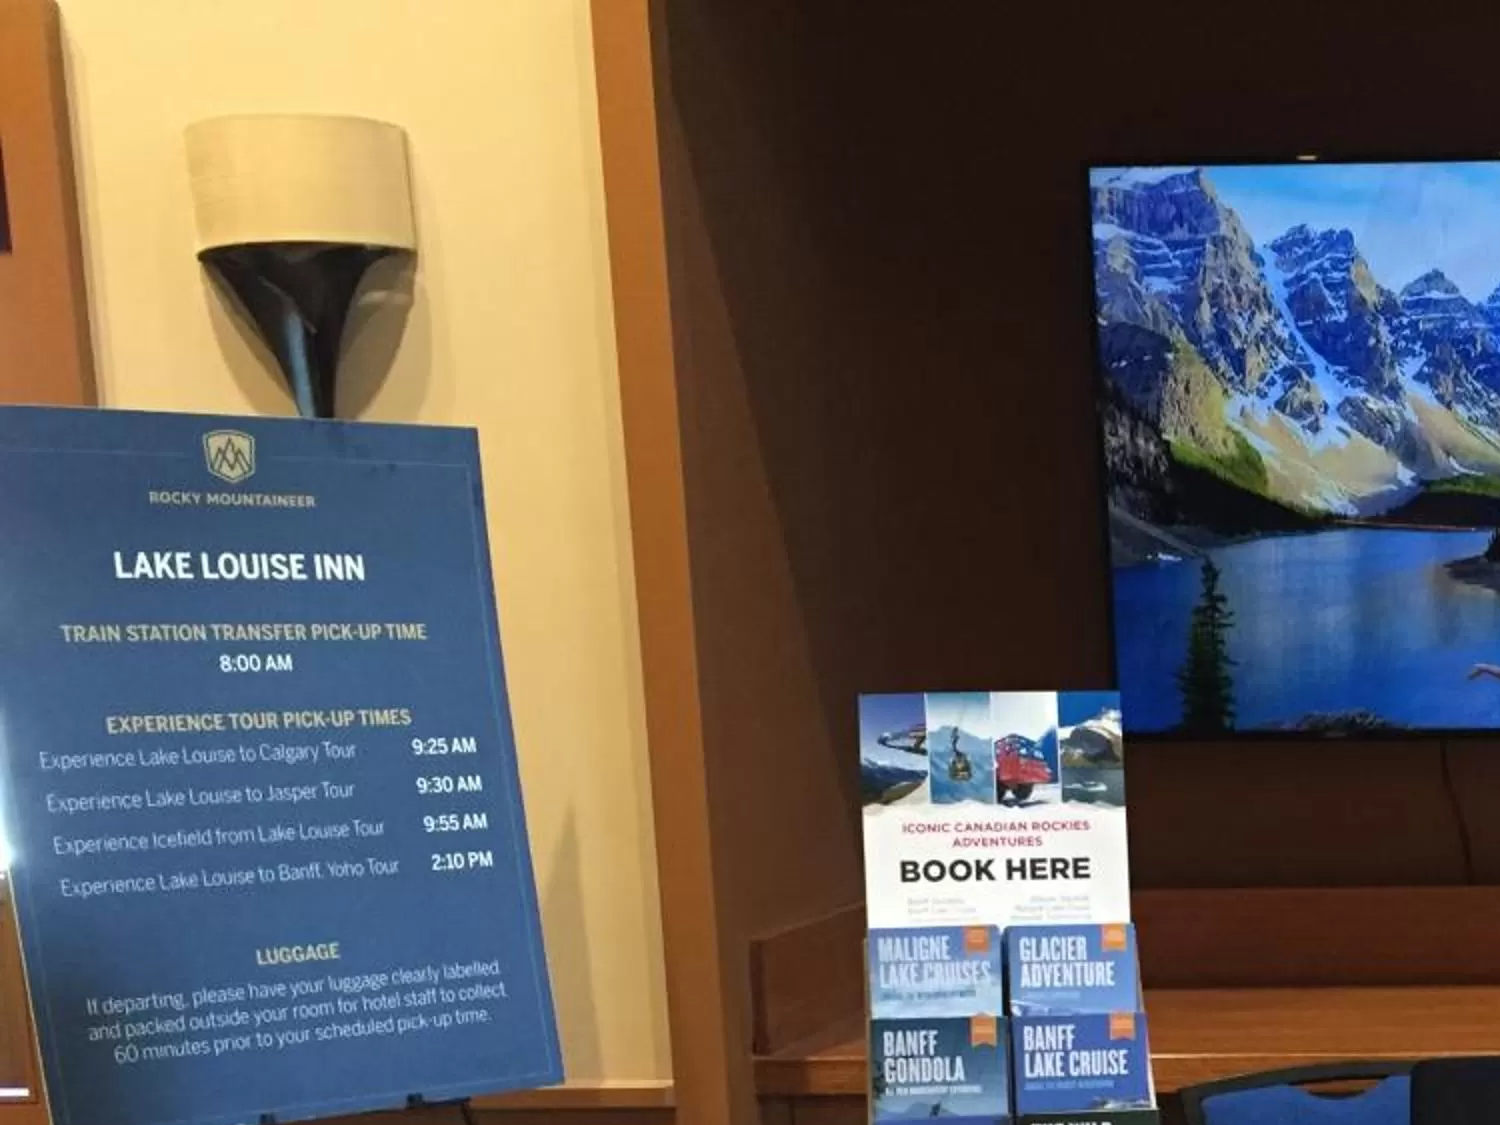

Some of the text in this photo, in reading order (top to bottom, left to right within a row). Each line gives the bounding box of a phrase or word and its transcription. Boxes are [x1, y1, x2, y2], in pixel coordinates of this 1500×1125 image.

[149, 491, 316, 508] ROCKY MOUNTAINEER
[113, 551, 365, 581] LAKE LOUISE INN
[59, 623, 427, 642] TRAIN STATION TRANSFER PICK-UP TIME
[219, 654, 293, 672] 8:00 AM
[106, 708, 412, 735] EXPERIENCE TOUR PICK-UP TIMES
[39, 741, 357, 773] Experience Lake Louise to Calgary Tour
[411, 736, 477, 755] 9:25 AM
[46, 781, 356, 815] Experience Lake Louise to Jasper Tour
[416, 775, 483, 794] 9:30 AM
[423, 813, 488, 833] 9:55 AM
[901, 820, 1091, 834] ICONIC CANADIAN ROCKIES
[53, 819, 385, 856] Experience Icefield from Lake Louise Tour
[952, 836, 1043, 848] ADVENTURES
[431, 851, 493, 871] 2:10 PM
[900, 857, 1091, 883] BOOK HERE
[60, 877, 155, 898] Experience
[158, 874, 199, 891] Lake
[201, 869, 255, 888] Louise
[257, 867, 275, 884] to
[326, 860, 366, 878] Yoho
[367, 857, 400, 876] Tour
[256, 942, 340, 965] LUGGAGE
[877, 936, 952, 963] MALIGNE
[1019, 936, 1088, 961] GLACIER
[879, 960, 992, 989] LAKE CRUISES
[1020, 961, 1115, 988] ADVENTURE
[87, 998, 99, 1016] If
[191, 987, 246, 1009] please
[247, 983, 288, 1001] have
[290, 978, 326, 998] your
[327, 971, 389, 993] luggage
[391, 965, 441, 985] clearly
[88, 981, 508, 1041] and packed outside your room for hotel staff to collect
[113, 1006, 493, 1065] 60 minutes prior to your scheduled pick-up time.
[883, 1029, 938, 1057] BANFF
[1023, 1024, 1076, 1051] BANFF
[884, 1056, 965, 1084] GONDOLA
[1025, 1049, 1129, 1078] LAKE CRUISE
